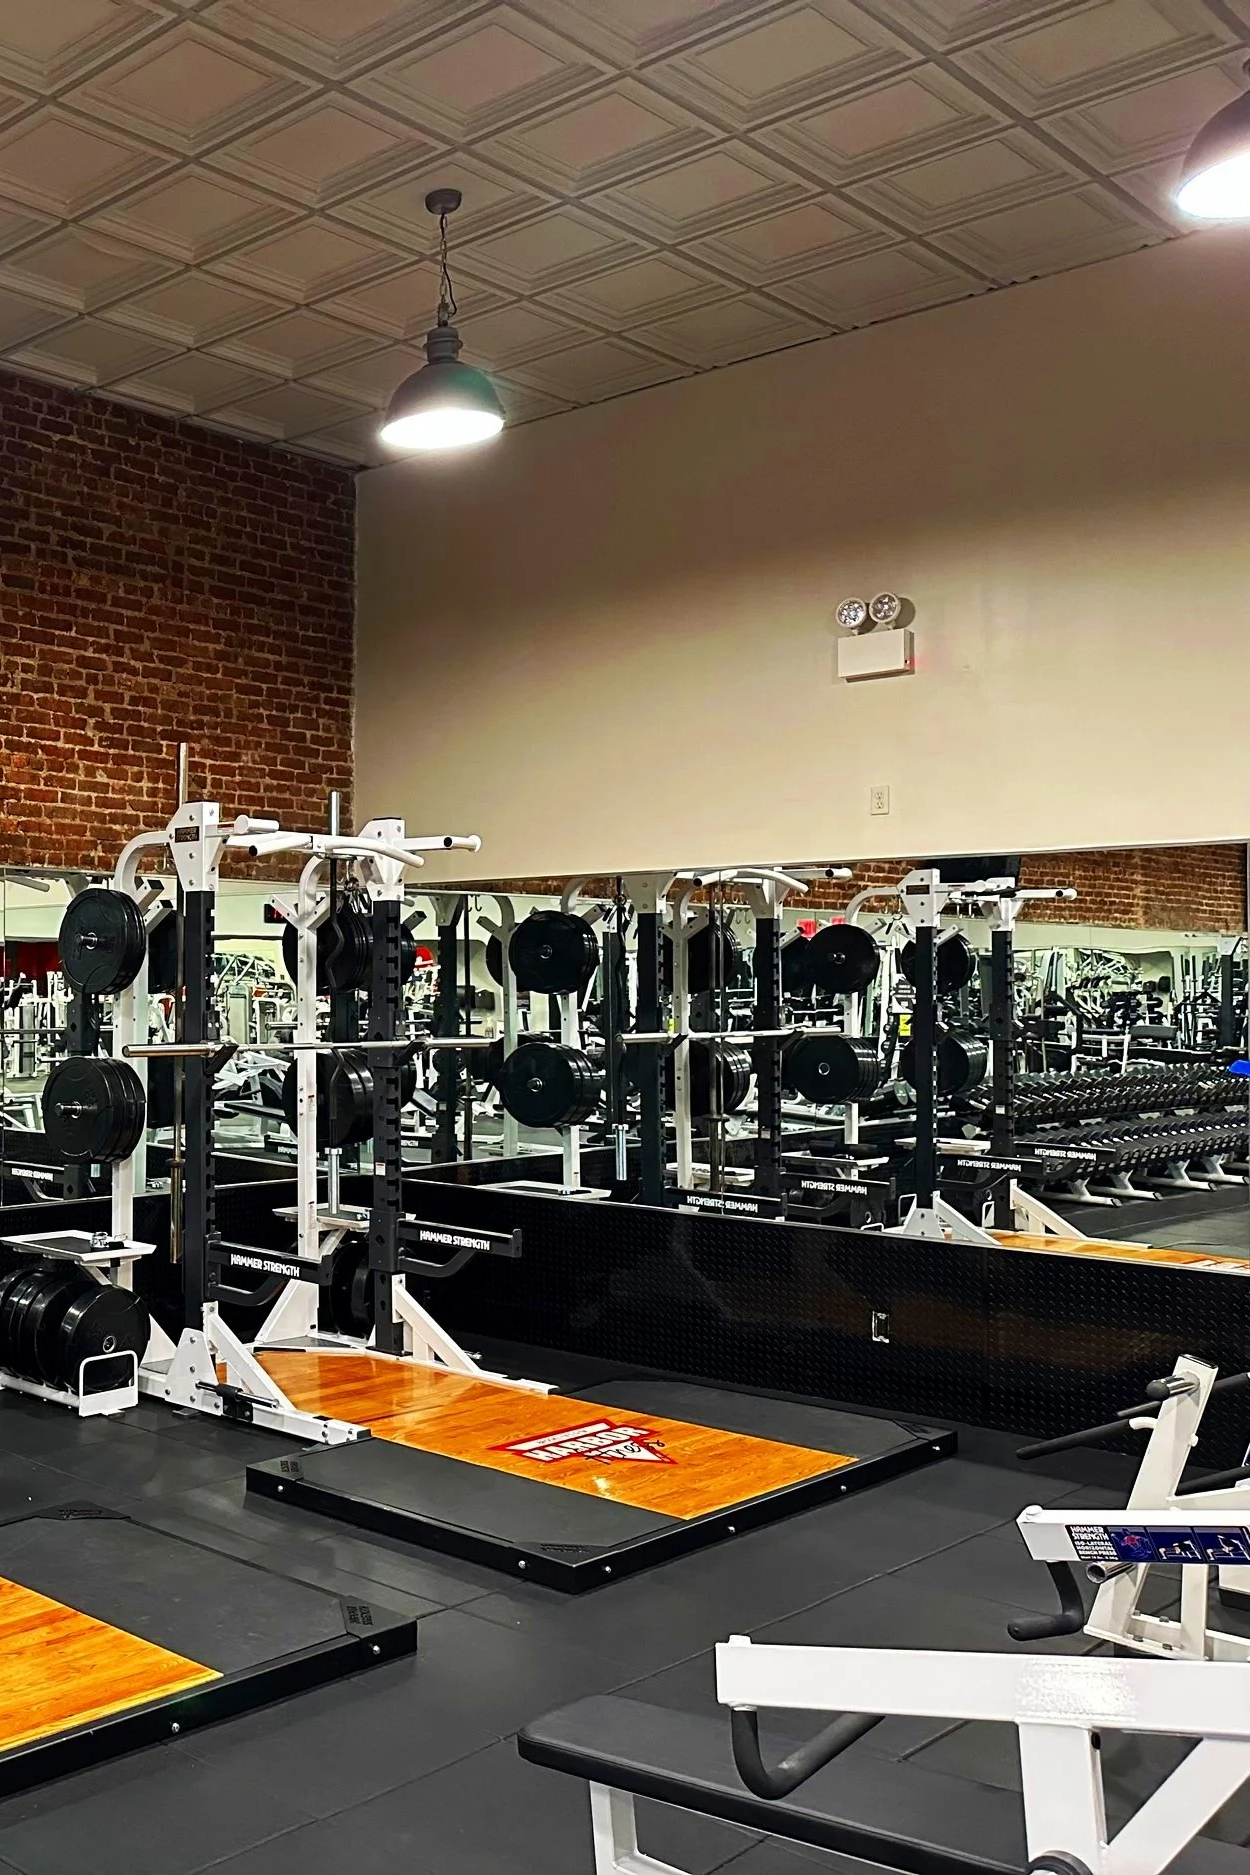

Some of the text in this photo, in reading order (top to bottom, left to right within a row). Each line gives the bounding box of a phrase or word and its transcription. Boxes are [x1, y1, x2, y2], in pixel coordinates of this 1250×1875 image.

[420, 1229, 491, 1251] HAMMER STRENGTH
[230, 1253, 301, 1278] HAMMER STRENGTH
[521, 1426, 651, 1462] HARBOR
[1070, 1525, 1104, 1533] HAMMER
